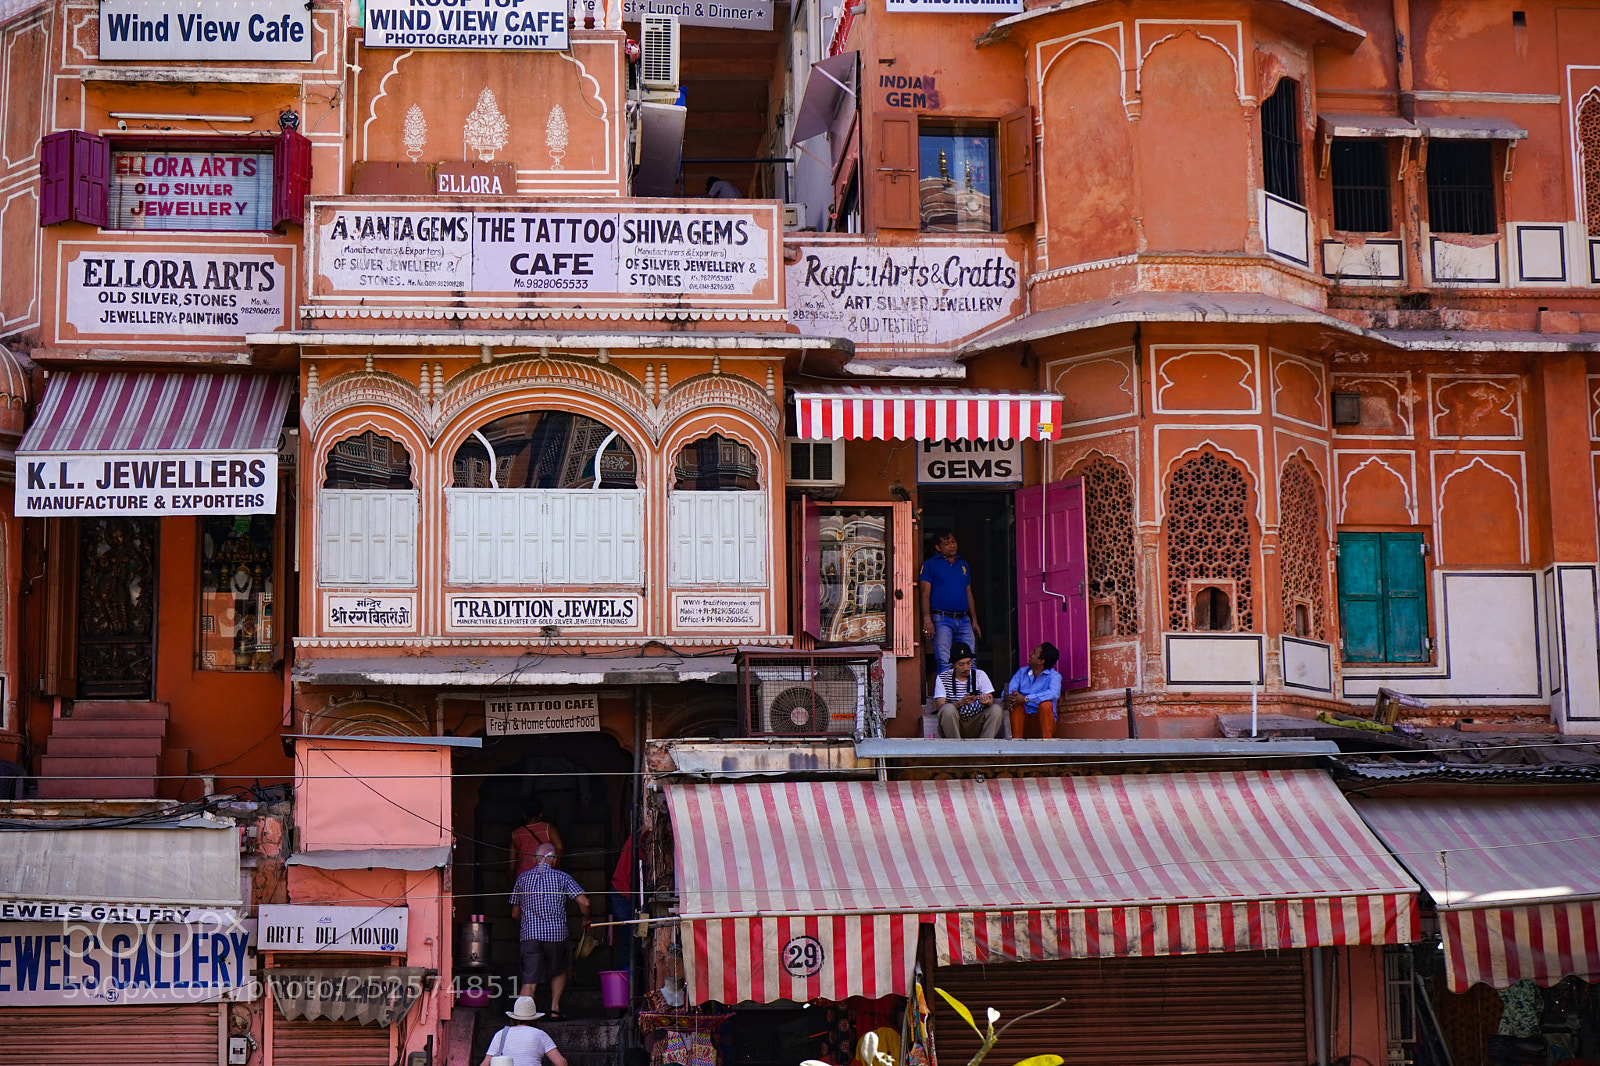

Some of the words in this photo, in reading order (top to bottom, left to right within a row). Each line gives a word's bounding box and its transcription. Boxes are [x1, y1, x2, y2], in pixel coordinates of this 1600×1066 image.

[648, 1, 690, 16] Lunch
[694, 3, 704, 16] &
[709, 4, 753, 20] Dinner
[108, 13, 169, 42] Wind
[178, 13, 240, 42] View
[248, 13, 304, 42] Cafe
[370, 10, 431, 31] WIND
[439, 11, 498, 31] VIEW
[505, 12, 564, 33] CAFE
[385, 34, 498, 45] PHOTOGRAPHY
[503, 35, 549, 46] POINT
[879, 75, 935, 90] INDIAN
[886, 91, 940, 109] GEMS
[116, 156, 195, 177] ELLORA
[199, 157, 257, 177] ARTS
[135, 182, 170, 195] OLD
[173, 183, 233, 196] SILVLER
[438, 174, 503, 194] ELLORA
[130, 200, 248, 216] JEWELLERY
[330, 215, 414, 240] AJANTA
[416, 216, 469, 241] GEMS
[477, 217, 515, 242] THE
[521, 218, 616, 243] TATTOO
[622, 219, 684, 244] SHIVA
[687, 220, 749, 245] GEMS
[333, 258, 347, 270] OF
[510, 253, 594, 275] CAFE
[625, 258, 640, 270] OF
[641, 258, 681, 271] SILVER
[683, 260, 746, 273] JEWELLERY
[748, 262, 757, 274] &
[930, 263, 944, 285] &
[943, 255, 1016, 288] Crafts
[82, 258, 198, 290] ELLORA
[202, 260, 276, 292] ARTS
[629, 273, 682, 287] STONES
[98, 291, 127, 304] OLD
[184, 293, 238, 308] STONES
[932, 296, 1003, 313] JEWELLERY
[99, 310, 172, 325] JEWELLERY
[178, 312, 239, 326] PAINTINGS
[26, 461, 85, 490] K.L.
[96, 459, 266, 490] JEWELLERS
[927, 459, 1013, 480] GEMS
[26, 494, 148, 511] MANUFACTURE
[153, 496, 166, 509] &
[171, 493, 265, 509] EXPORTERS
[453, 600, 554, 618] TRADITION
[557, 599, 634, 618] JEWELS
[490, 702, 513, 712] THE
[515, 700, 561, 711] TATTOO
[564, 699, 595, 710] CAFE
[521, 717, 544, 730] Home
[545, 714, 575, 729] Cooked
[576, 713, 595, 728] Food
[91, 906, 190, 922] GALLERY
[315, 927, 339, 944] DEL
[350, 927, 399, 945] MONDO
[112, 932, 250, 989] GALLERY
[788, 943, 817, 968] 29
